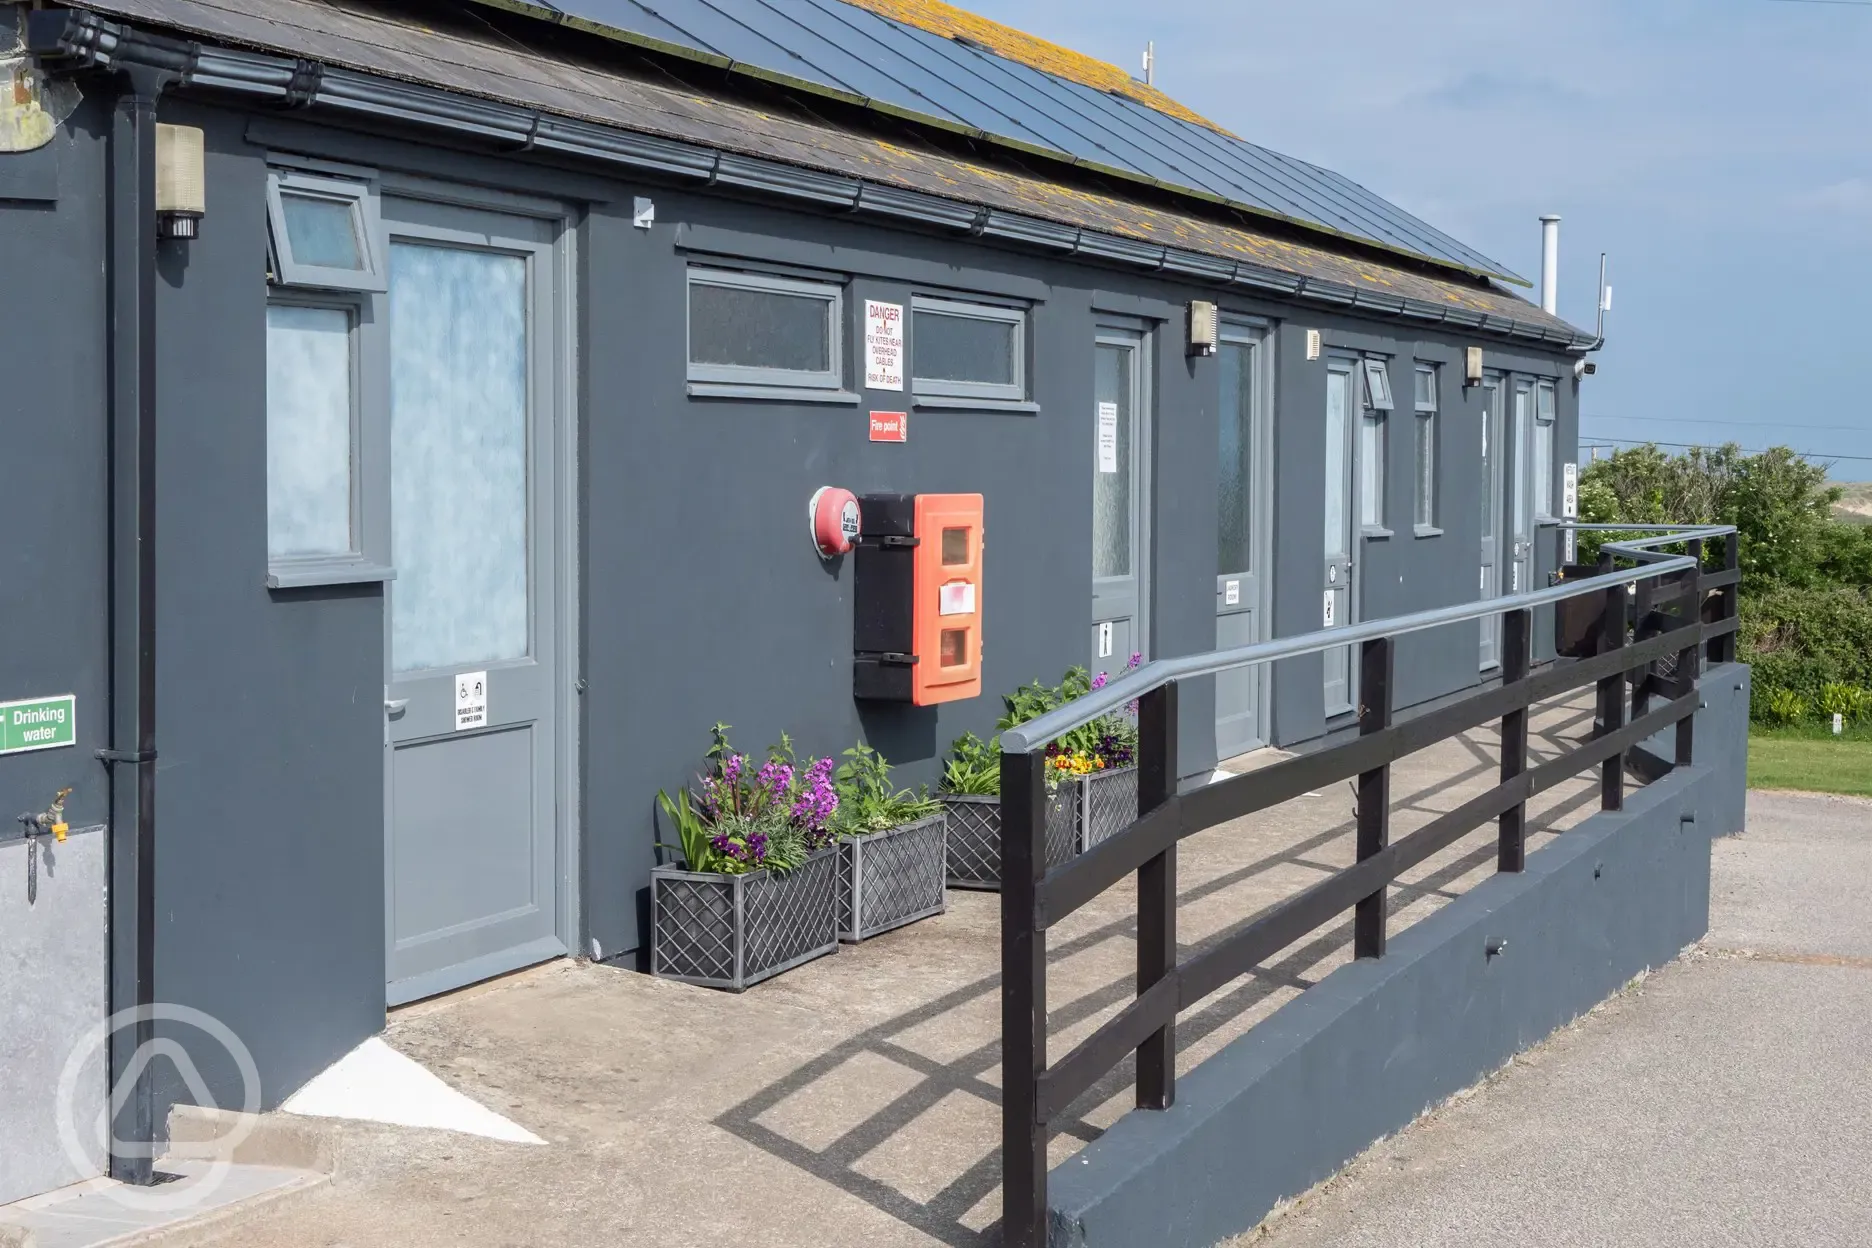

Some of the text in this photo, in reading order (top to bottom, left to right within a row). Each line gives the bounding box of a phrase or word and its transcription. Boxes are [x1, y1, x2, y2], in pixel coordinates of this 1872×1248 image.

[869, 304, 900, 321] DANGER
[876, 326, 893, 336] DO NOT
[876, 336, 889, 346] KITES
[889, 338, 902, 347] NEAR
[872, 346, 897, 357] OVERHEAD
[876, 356, 894, 367] CABLES
[868, 373, 901, 384] RISK OF DEATH
[871, 419, 898, 434] Fire point
[13, 707, 65, 725] Drinking
[23, 726, 57, 742] water
